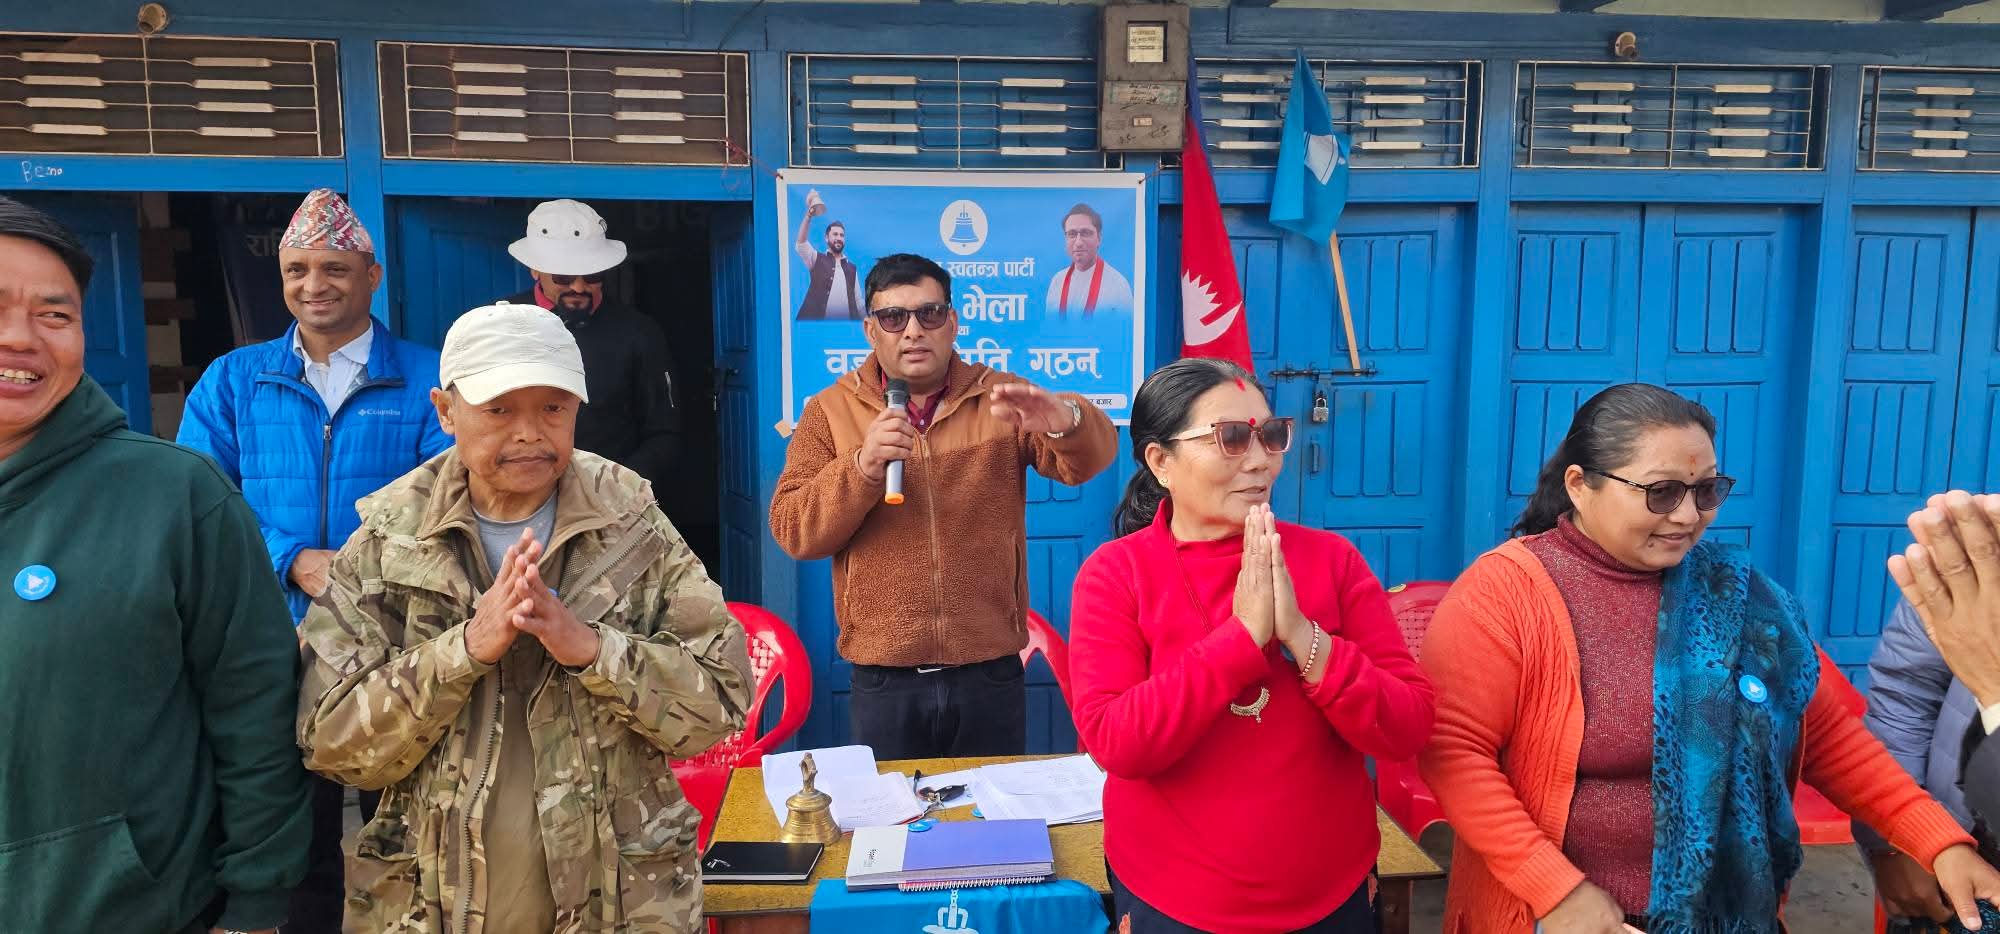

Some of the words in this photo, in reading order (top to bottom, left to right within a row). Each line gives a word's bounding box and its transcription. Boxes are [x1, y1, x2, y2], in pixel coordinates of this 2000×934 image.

[1004, 257, 1035, 276] पार्टी
[962, 284, 1028, 323] भेला
[824, 349, 874, 375] वड
